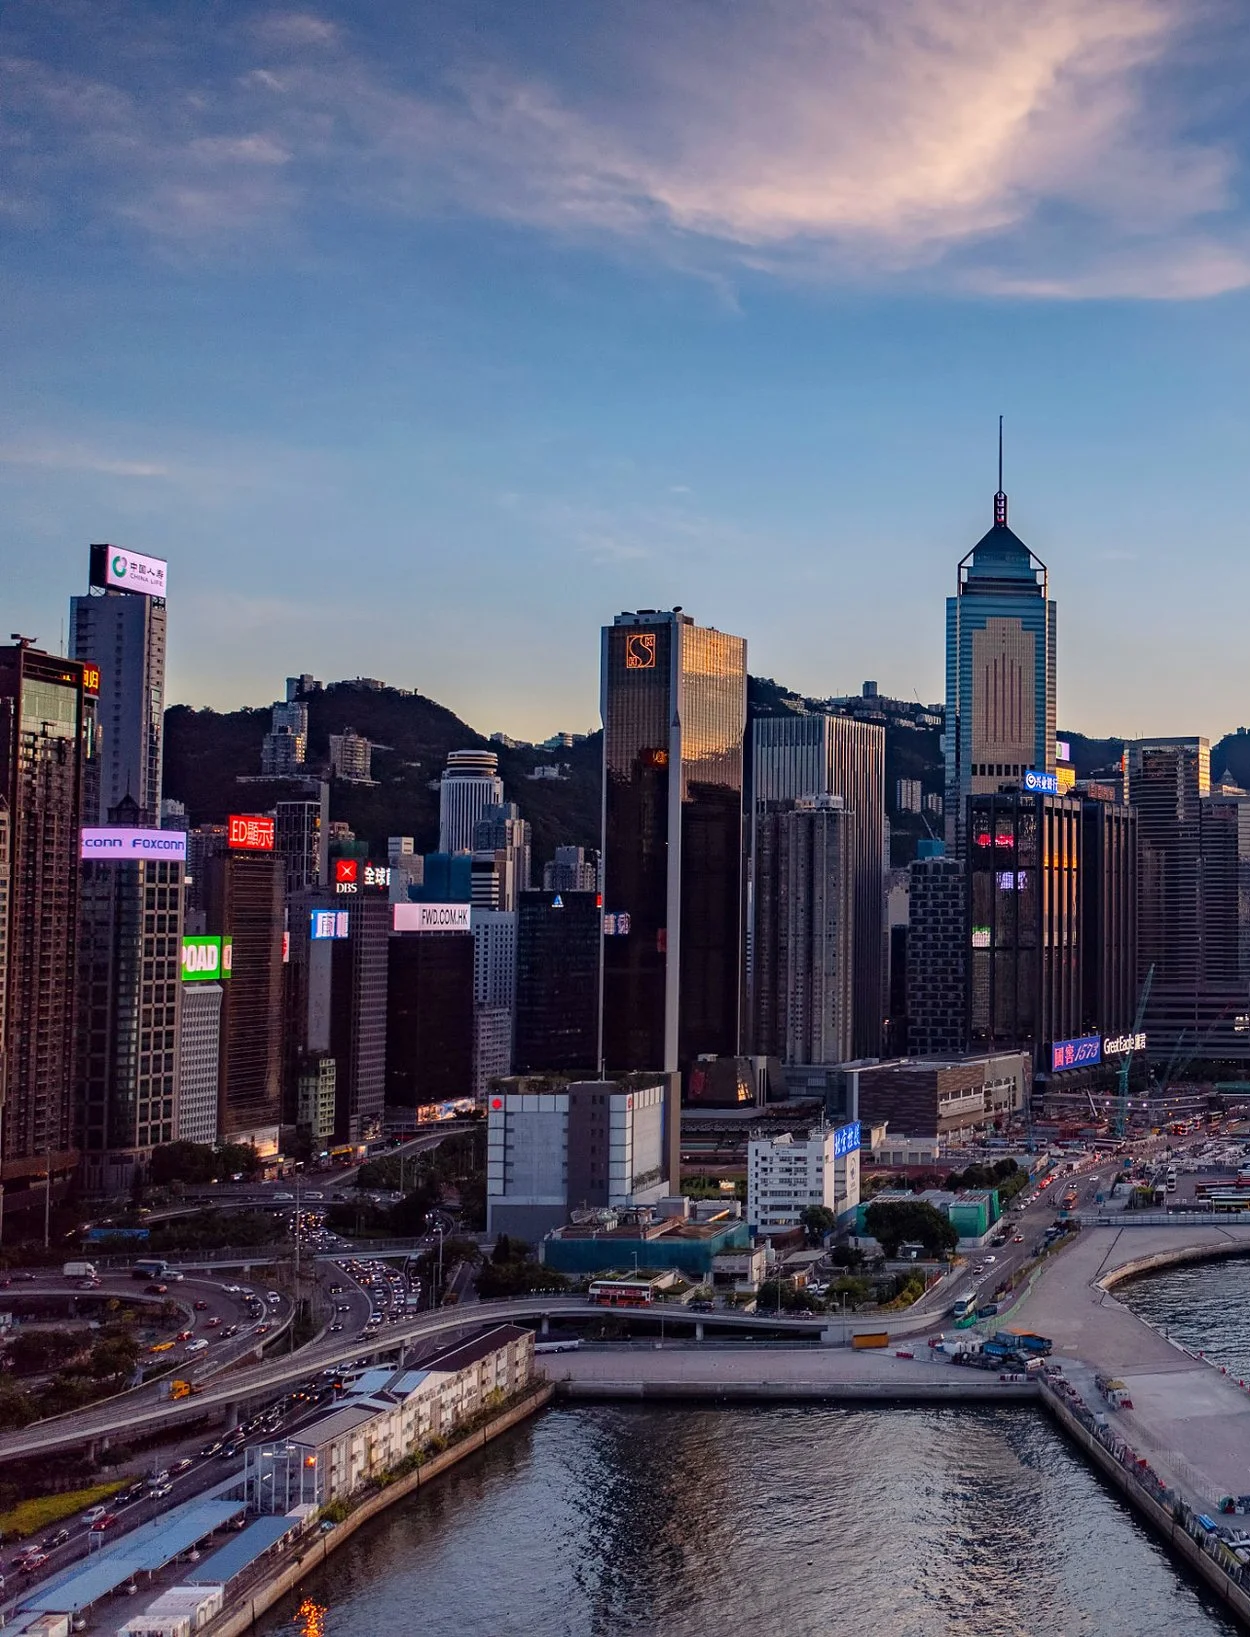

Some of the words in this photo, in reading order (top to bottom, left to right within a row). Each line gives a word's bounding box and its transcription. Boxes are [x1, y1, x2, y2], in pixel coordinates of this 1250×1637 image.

[130, 573, 148, 582] CHINA
[150, 579, 164, 587] LIFE
[336, 882, 358, 894] DBS
[422, 909, 468, 925] FWD.COM.HK
[1074, 1041, 1099, 1062] 1573
[1104, 1038, 1119, 1054] Great
[1119, 1033, 1134, 1054] Eagle
